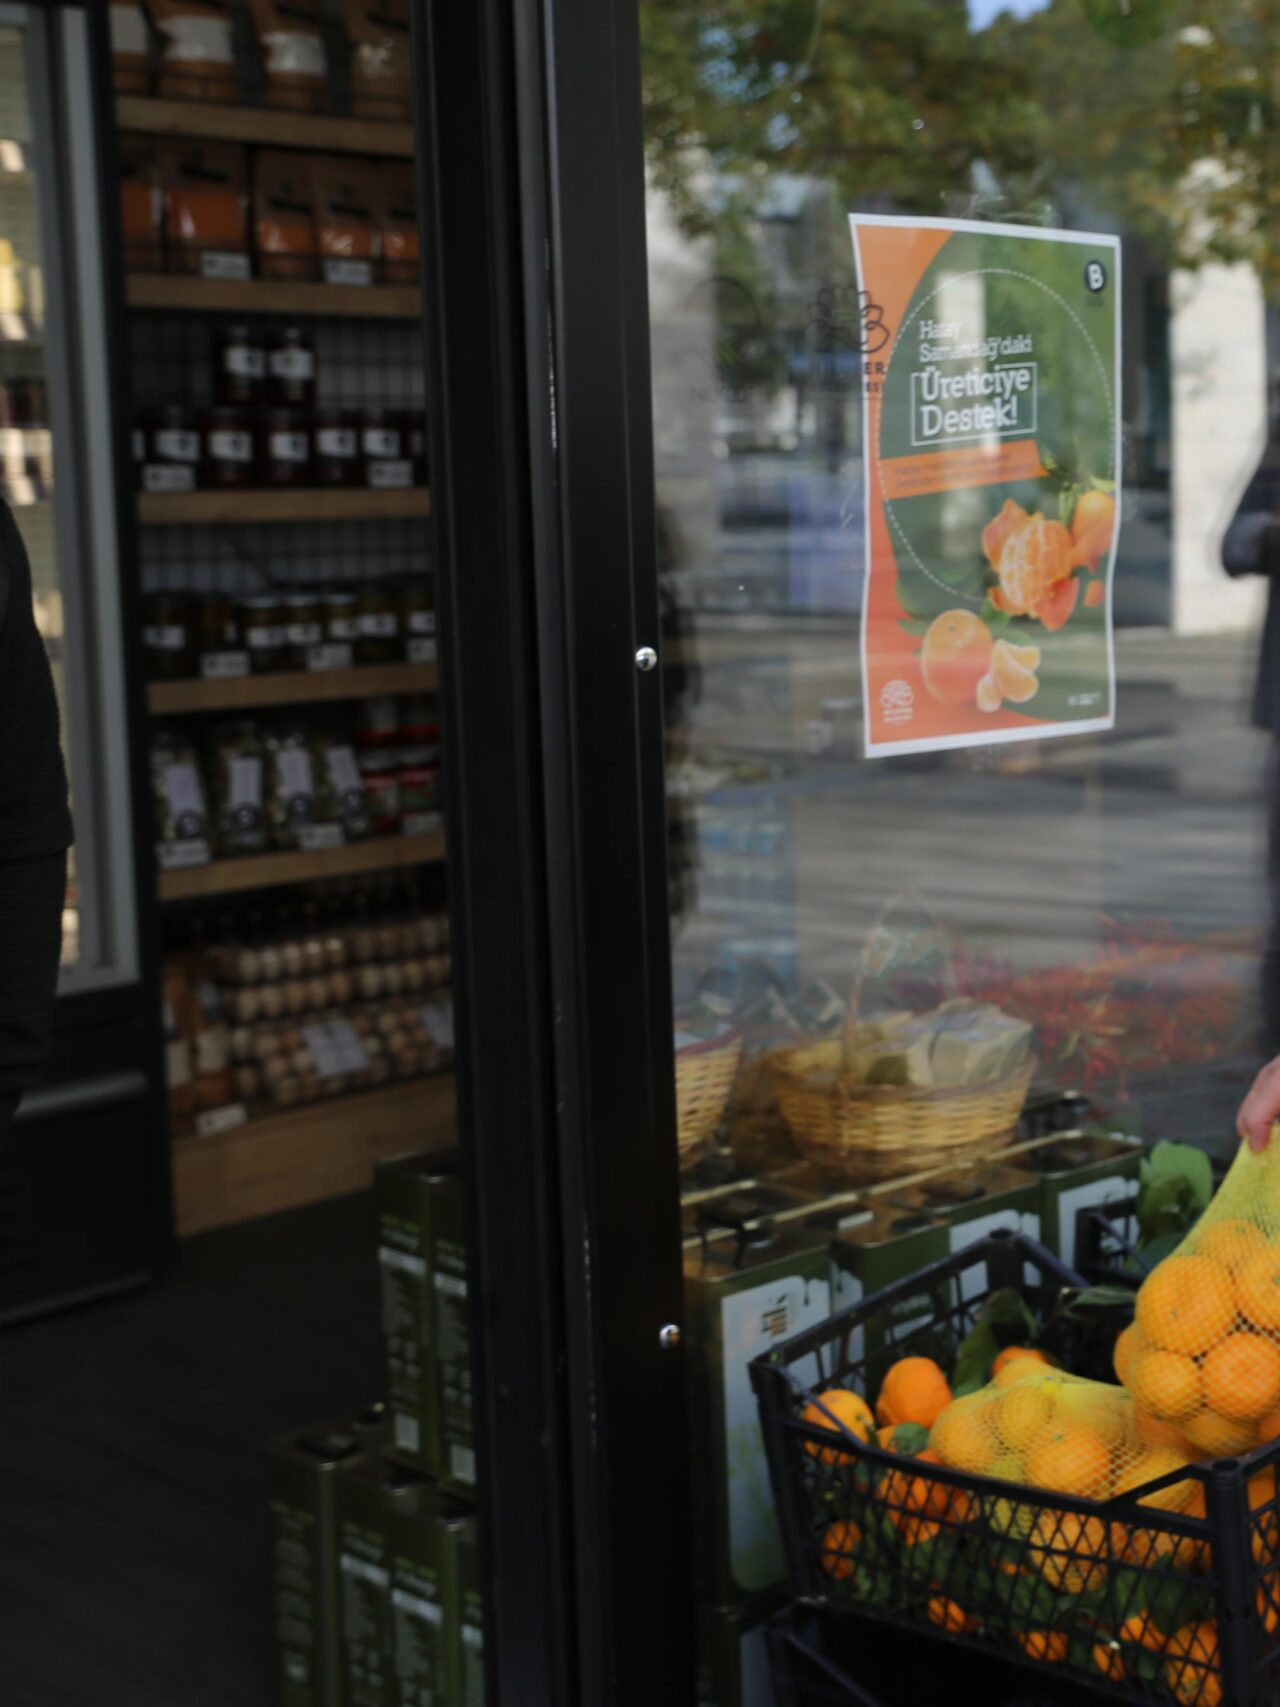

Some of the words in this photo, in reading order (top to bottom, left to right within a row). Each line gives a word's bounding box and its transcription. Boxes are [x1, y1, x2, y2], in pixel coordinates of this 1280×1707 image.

[1088, 263, 1104, 290] B
[920, 366, 1032, 402] Üreticiye
[920, 395, 1018, 437] Destek!
